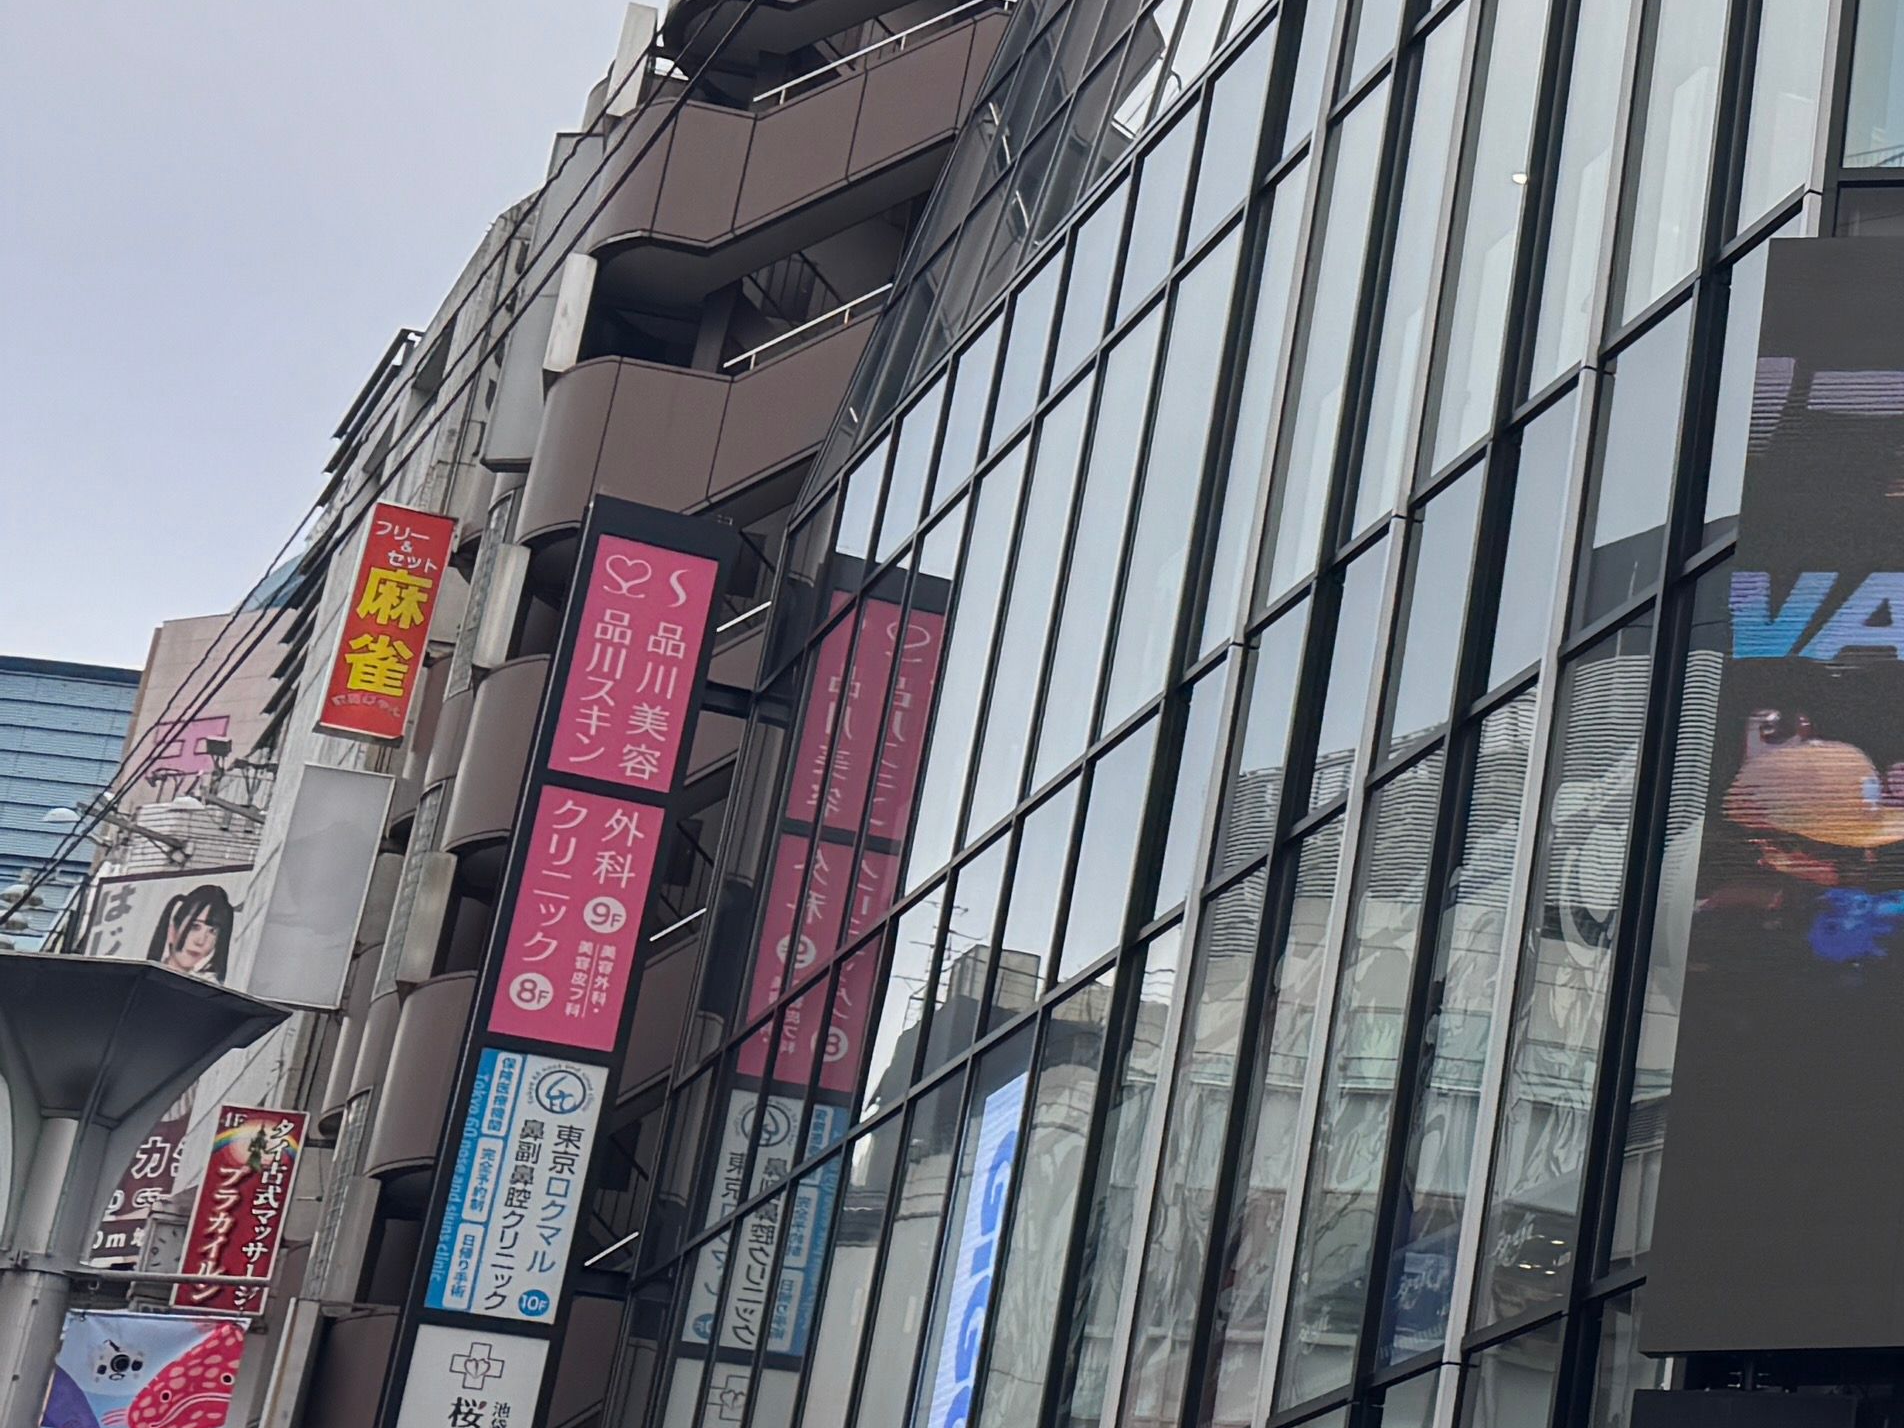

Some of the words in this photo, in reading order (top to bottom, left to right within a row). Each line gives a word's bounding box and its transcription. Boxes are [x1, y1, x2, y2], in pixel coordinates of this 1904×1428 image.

[375, 520, 430, 541] フリー
[387, 551, 438, 573] セット
[344, 566, 433, 697] 麻雀
[568, 608, 633, 763] 品川スキン
[618, 621, 686, 780] 品川美容
[522, 799, 588, 961] クリニック
[592, 808, 645, 889] 外科
[590, 902, 622, 928] 9F
[516, 978, 550, 1005] 8F
[485, 1119, 545, 1311] 鼻副鼻腔クリニック
[526, 1124, 586, 1273] 東京ロクマル
[522, 1294, 548, 1311] 10F
